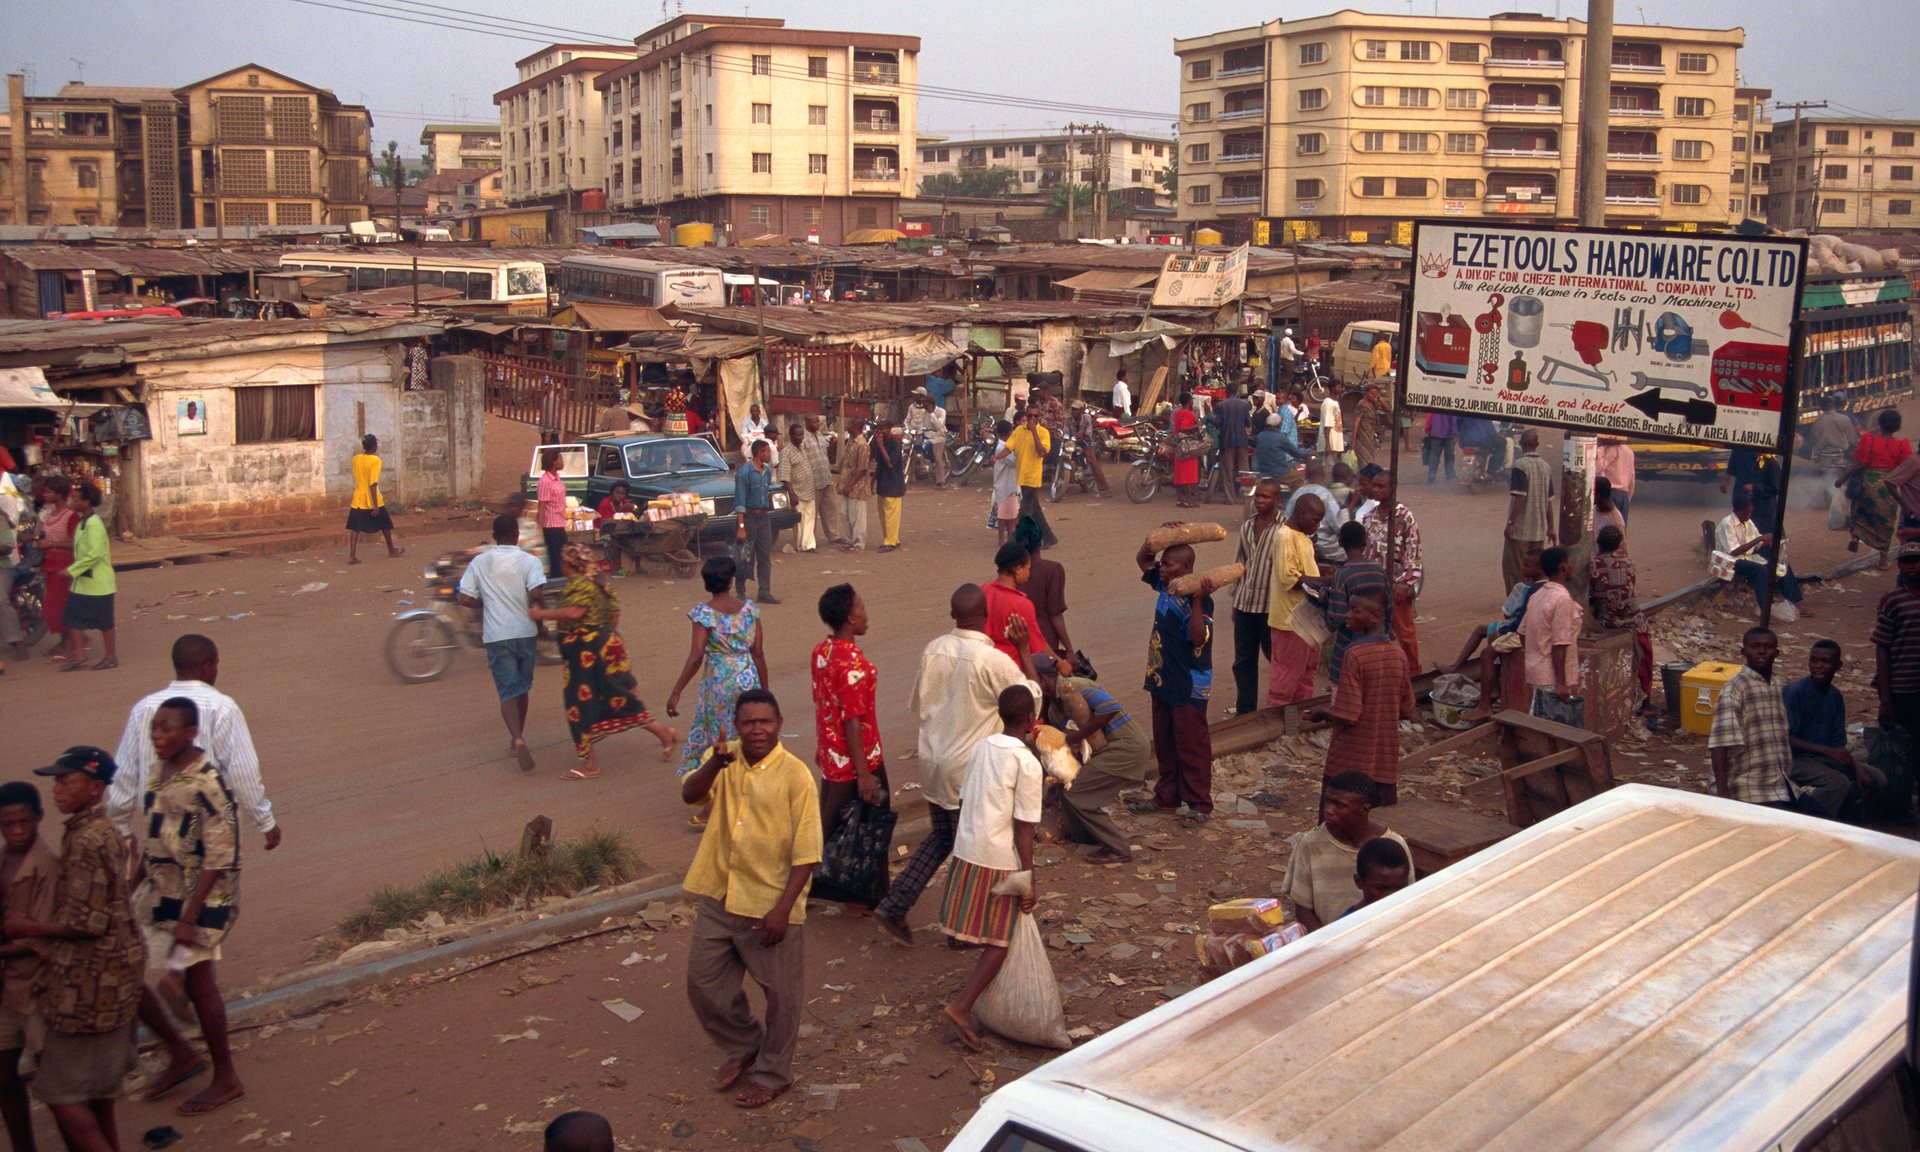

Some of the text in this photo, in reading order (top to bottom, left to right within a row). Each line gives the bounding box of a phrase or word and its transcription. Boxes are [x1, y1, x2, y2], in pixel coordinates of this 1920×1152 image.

[1453, 232, 1579, 274] EZETOOLS
[1587, 239, 1713, 283] HARDWARE
[1456, 269, 1463, 280] A
[1523, 273, 1556, 286] CHEZE
[1560, 275, 1648, 293] INTERNATIONAL
[1656, 282, 1716, 297] COMPANY
[1725, 286, 1757, 300] LTD.
[1476, 281, 1535, 296] Reliable
[1537, 286, 1571, 297] Name
[1573, 288, 1588, 299] in
[1591, 289, 1626, 302] Tools
[1630, 294, 1657, 305] and
[1662, 295, 1741, 312] Machinery)
[1811, 323, 1903, 353] TIME SHALL TELL
[1496, 389, 1626, 414] Wholesale and Retail!
[1704, 427, 1729, 441] AREA
